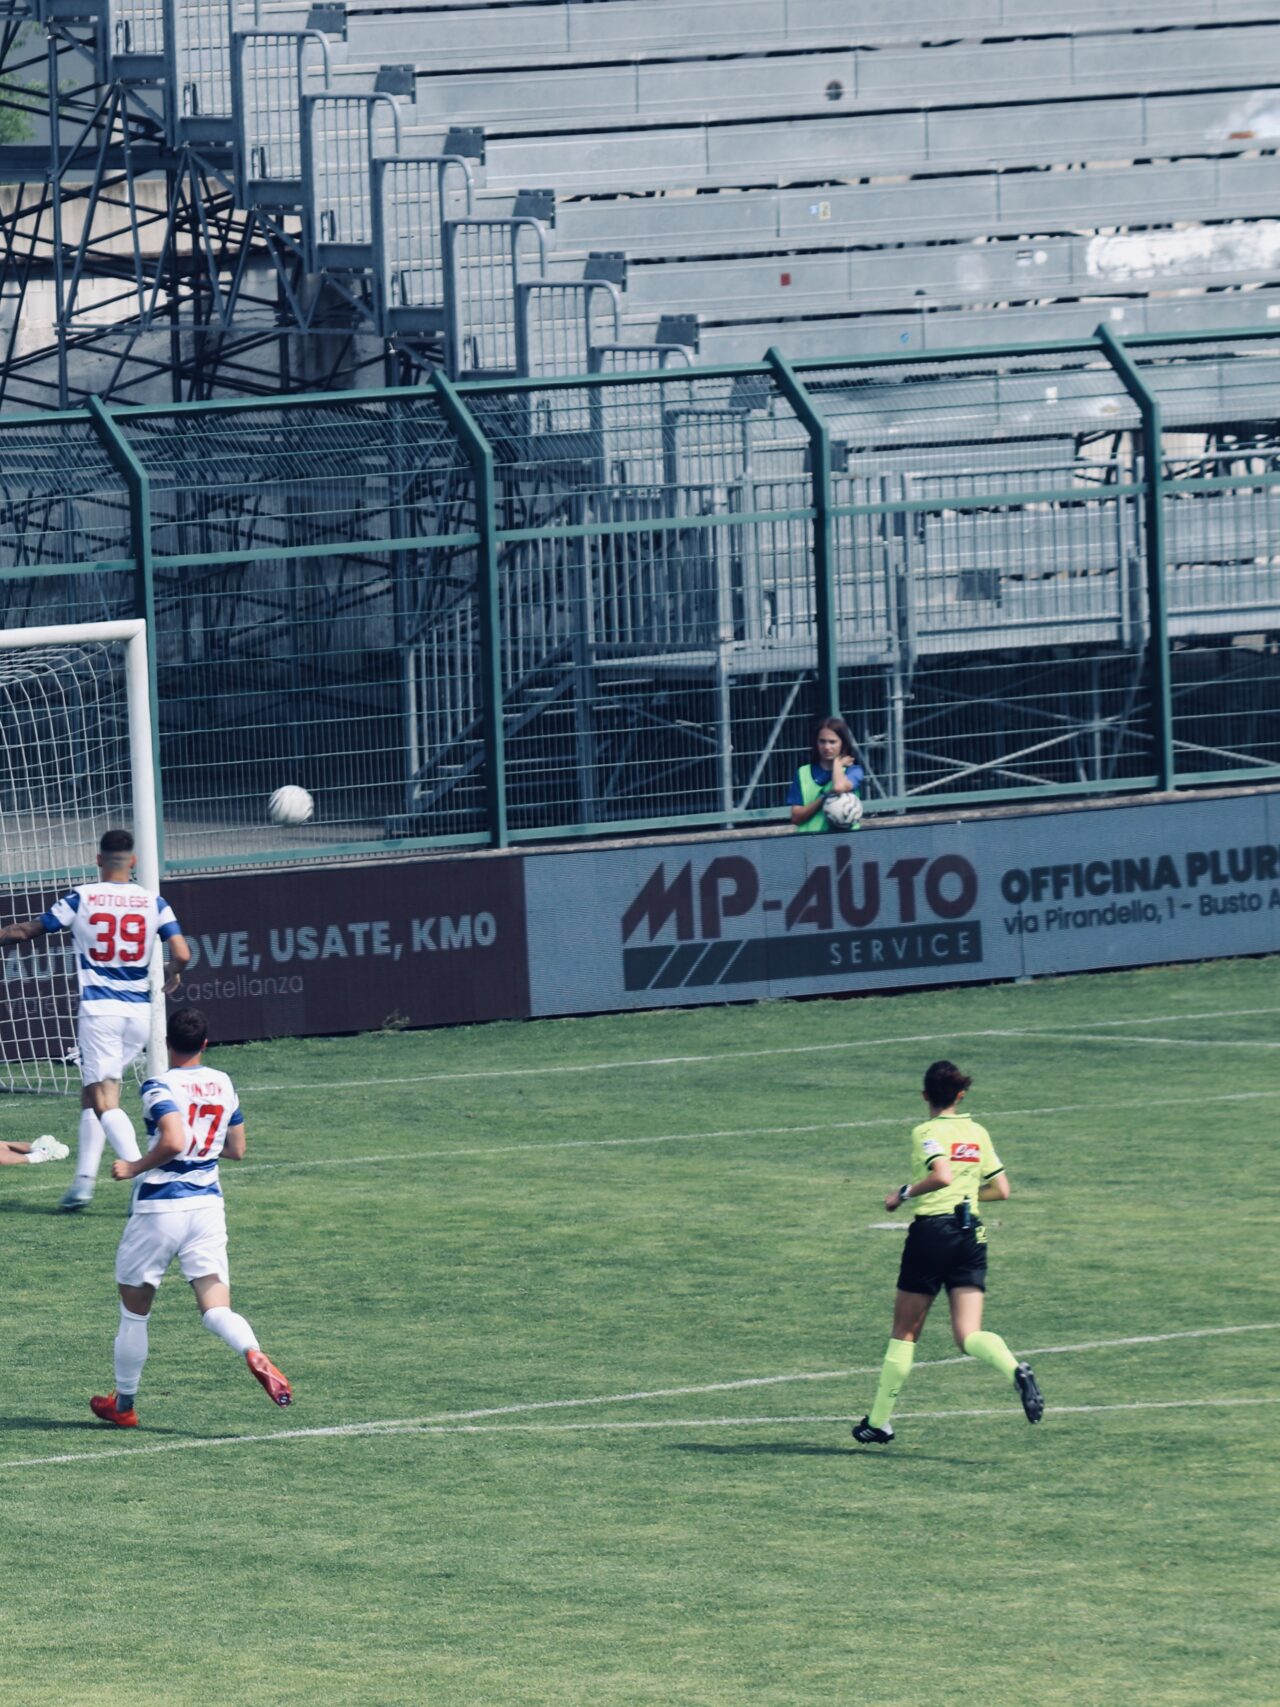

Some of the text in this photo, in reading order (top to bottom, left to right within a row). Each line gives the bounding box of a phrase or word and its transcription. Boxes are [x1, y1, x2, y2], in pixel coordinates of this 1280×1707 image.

[1001, 844, 1280, 905] OFFICINA PLUR
[1004, 909, 1039, 936] via
[1045, 899, 1163, 932] Pirandello,
[1166, 895, 1176, 919] 1
[1198, 890, 1263, 917] Busto
[88, 912, 147, 963] 39
[270, 920, 404, 962] USATE,
[830, 930, 972, 966] SERVICE
[186, 1102, 225, 1158] 17
